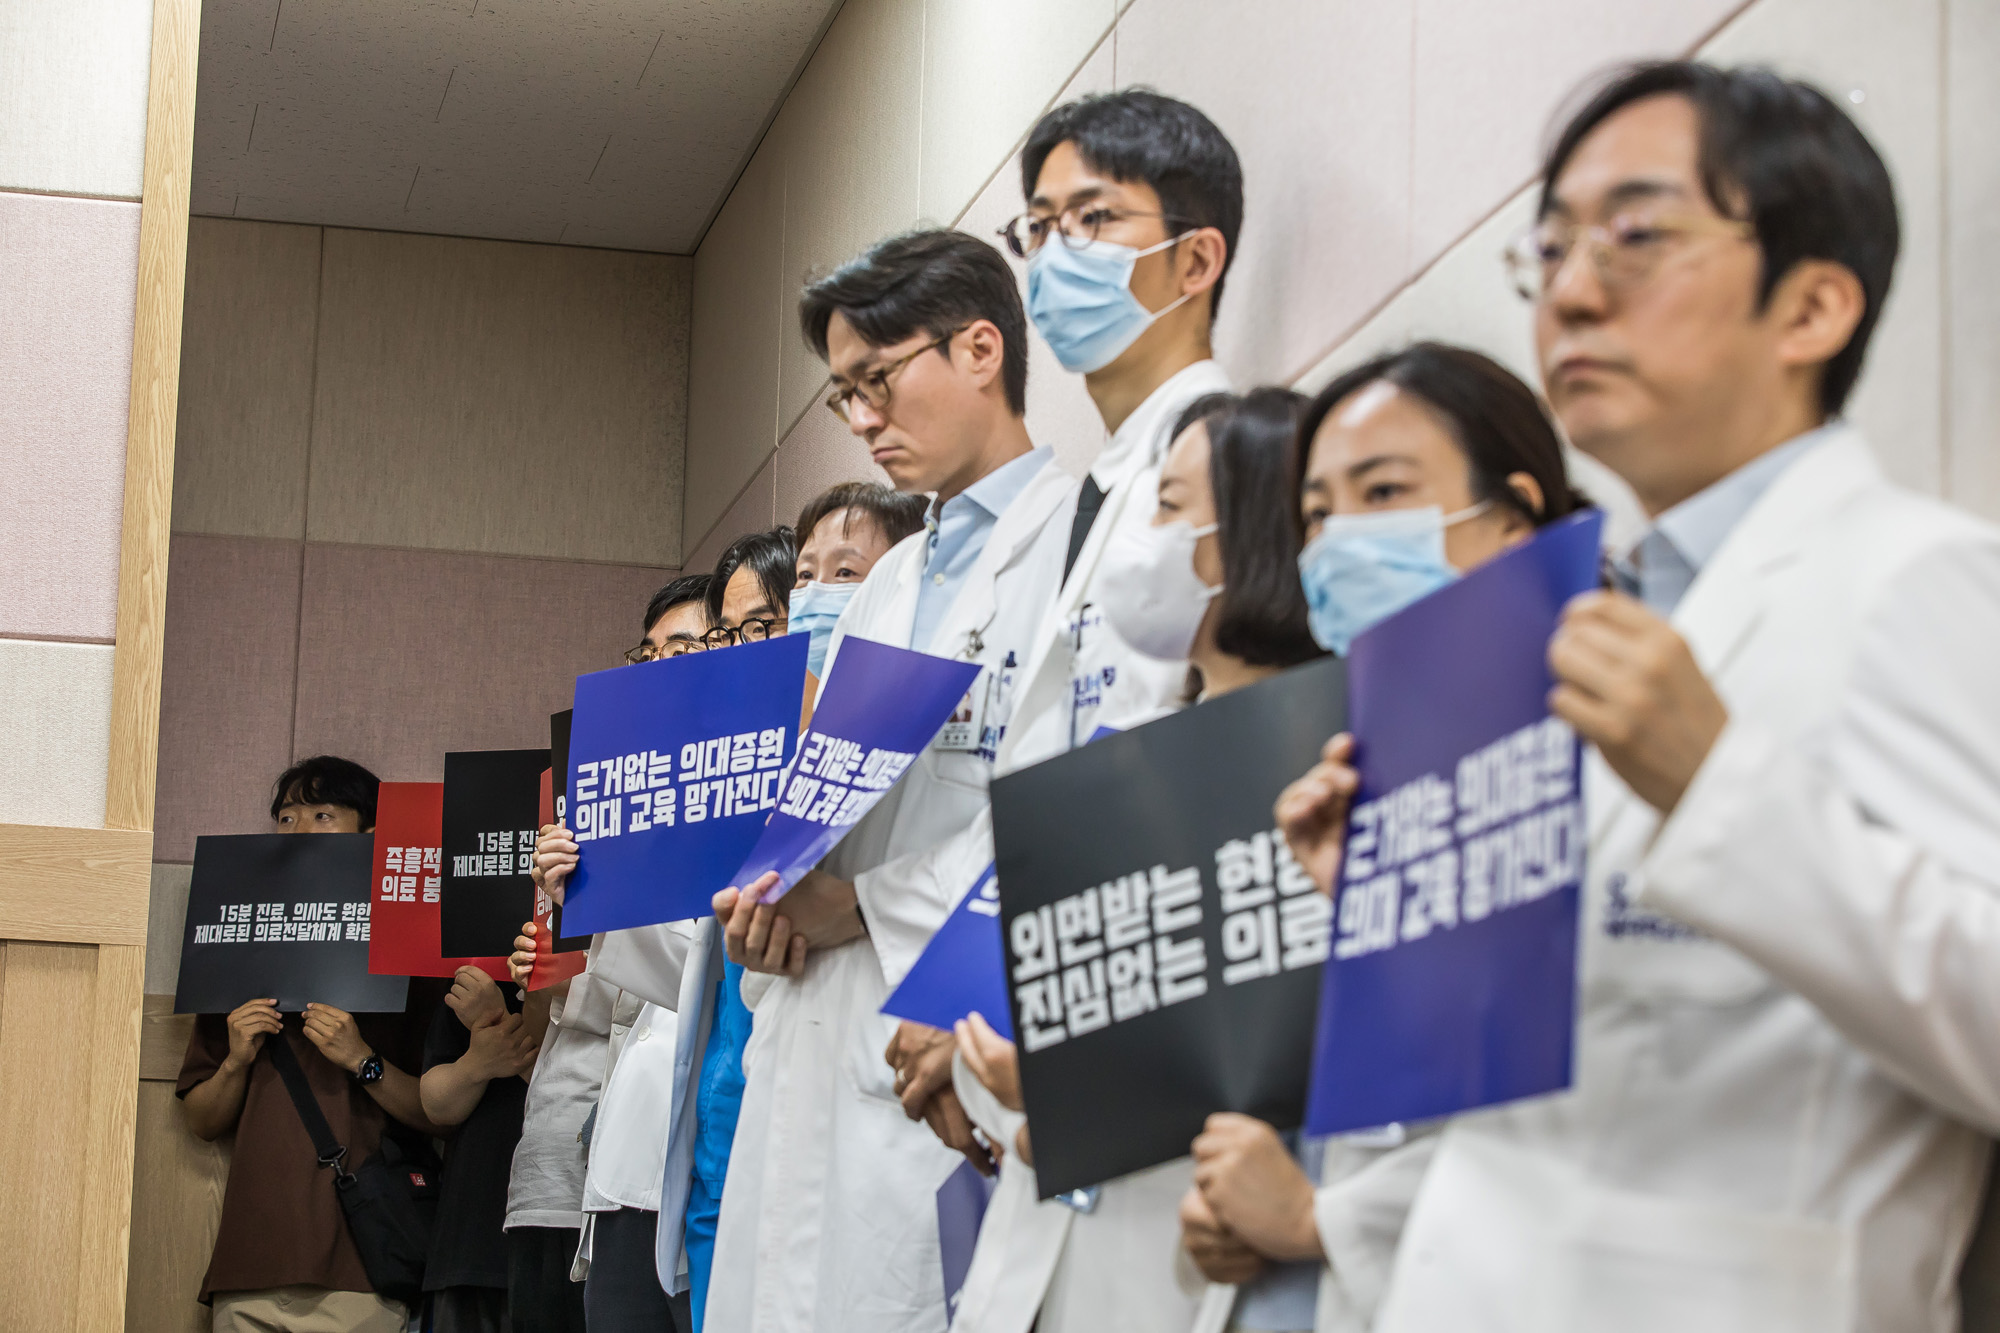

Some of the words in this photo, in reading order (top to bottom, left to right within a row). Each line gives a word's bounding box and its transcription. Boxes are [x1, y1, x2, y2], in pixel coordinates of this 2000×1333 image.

[576, 750, 672, 802] 근거없는
[678, 727, 786, 782] 의대증원
[798, 731, 865, 785] 근거없는
[575, 798, 622, 842] 의대
[629, 788, 676, 833] 교육
[684, 768, 788, 824] 망가진다
[779, 774, 822, 819] 의대
[478, 831, 514, 852] 15분
[518, 830, 539, 851] 진
[1344, 771, 1454, 882] 근거없는
[386, 847, 442, 874] 즉흥적
[453, 854, 513, 877] 제대로된
[220, 904, 252, 922] 15분
[256, 903, 288, 923] 진료,
[292, 902, 338, 921] 의사도
[381, 876, 417, 902] 의료
[423, 876, 441, 903] 붕
[1333, 870, 1399, 962] 의대
[1400, 849, 1460, 943] 교육
[194, 923, 251, 943] 제대로된
[254, 922, 342, 942] 의료전달체계
[1009, 863, 1203, 982] 외면받는
[1015, 936, 1208, 1054] 진심없는
[1222, 891, 1334, 986] 의료
